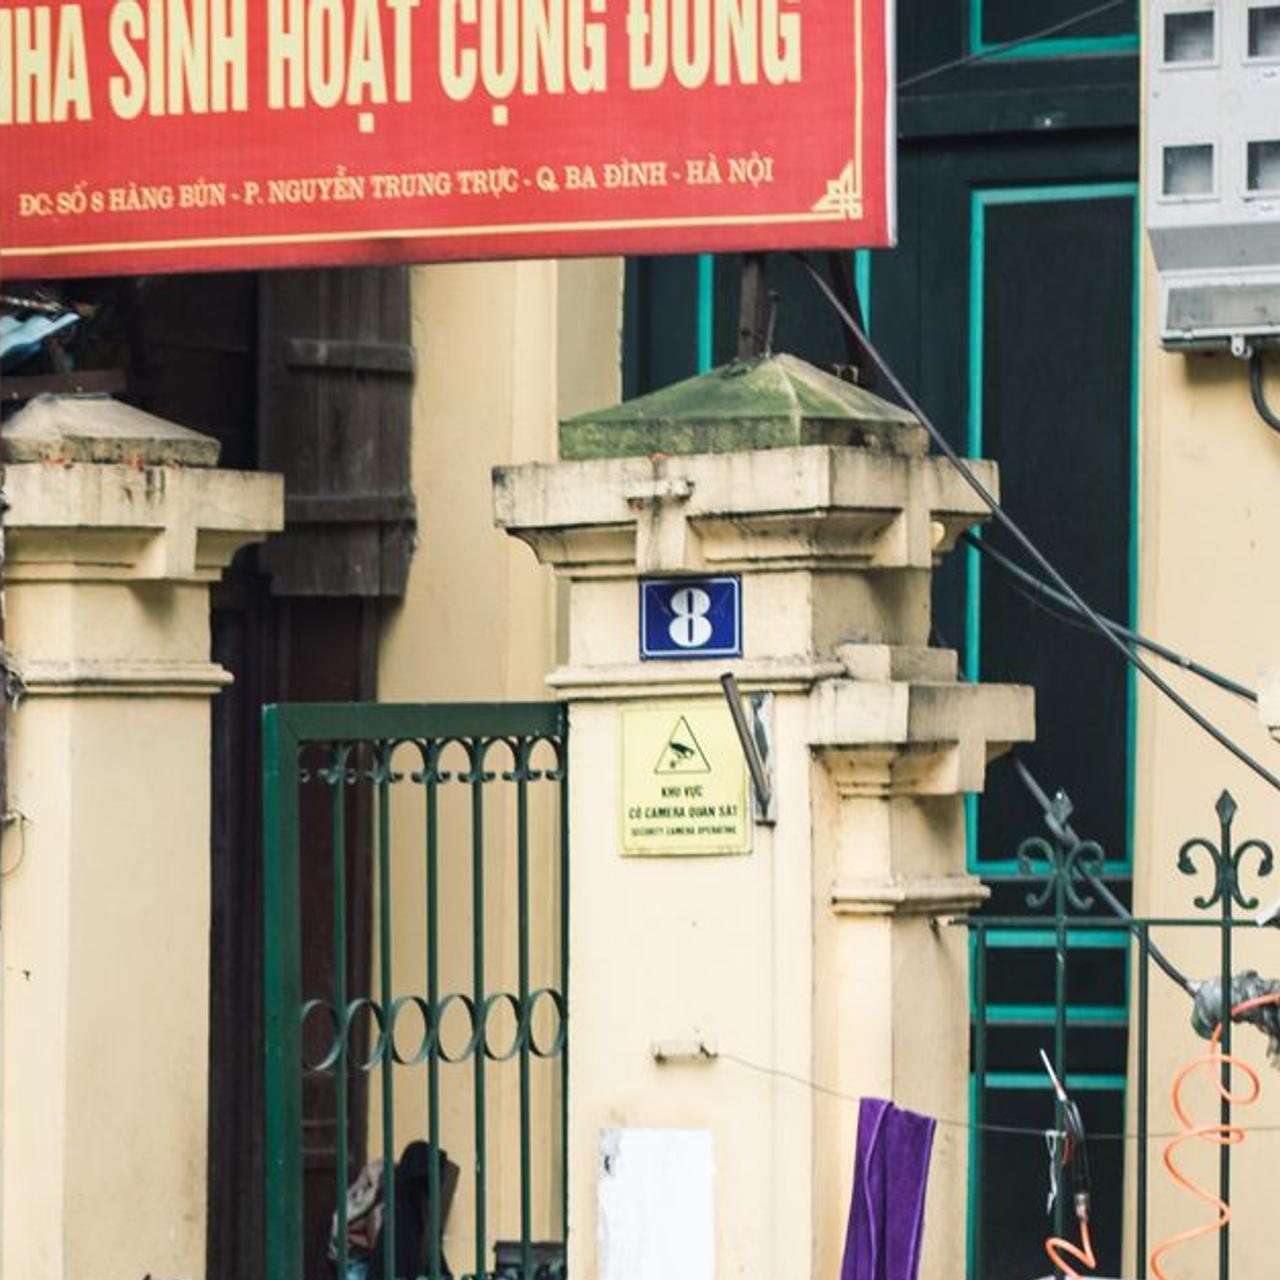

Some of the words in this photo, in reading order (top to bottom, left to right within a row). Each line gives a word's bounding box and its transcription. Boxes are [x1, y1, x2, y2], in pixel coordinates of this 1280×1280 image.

[108, 0, 248, 120] SINH
[267, 0, 420, 133] HOẠT
[110, 182, 175, 212] HÀNG
[179, 177, 226, 208] BÚN
[244, 182, 264, 205] P.
[268, 165, 365, 203] NGUYỄN
[371, 172, 452, 198] TRUNG
[457, 167, 519, 199] TRỰC
[565, 165, 597, 190] BA
[603, 158, 668, 188] ĐÌNH
[686, 154, 722, 185] HÀ
[729, 152, 774, 188] NỘI
[668, 587, 713, 648] 8
